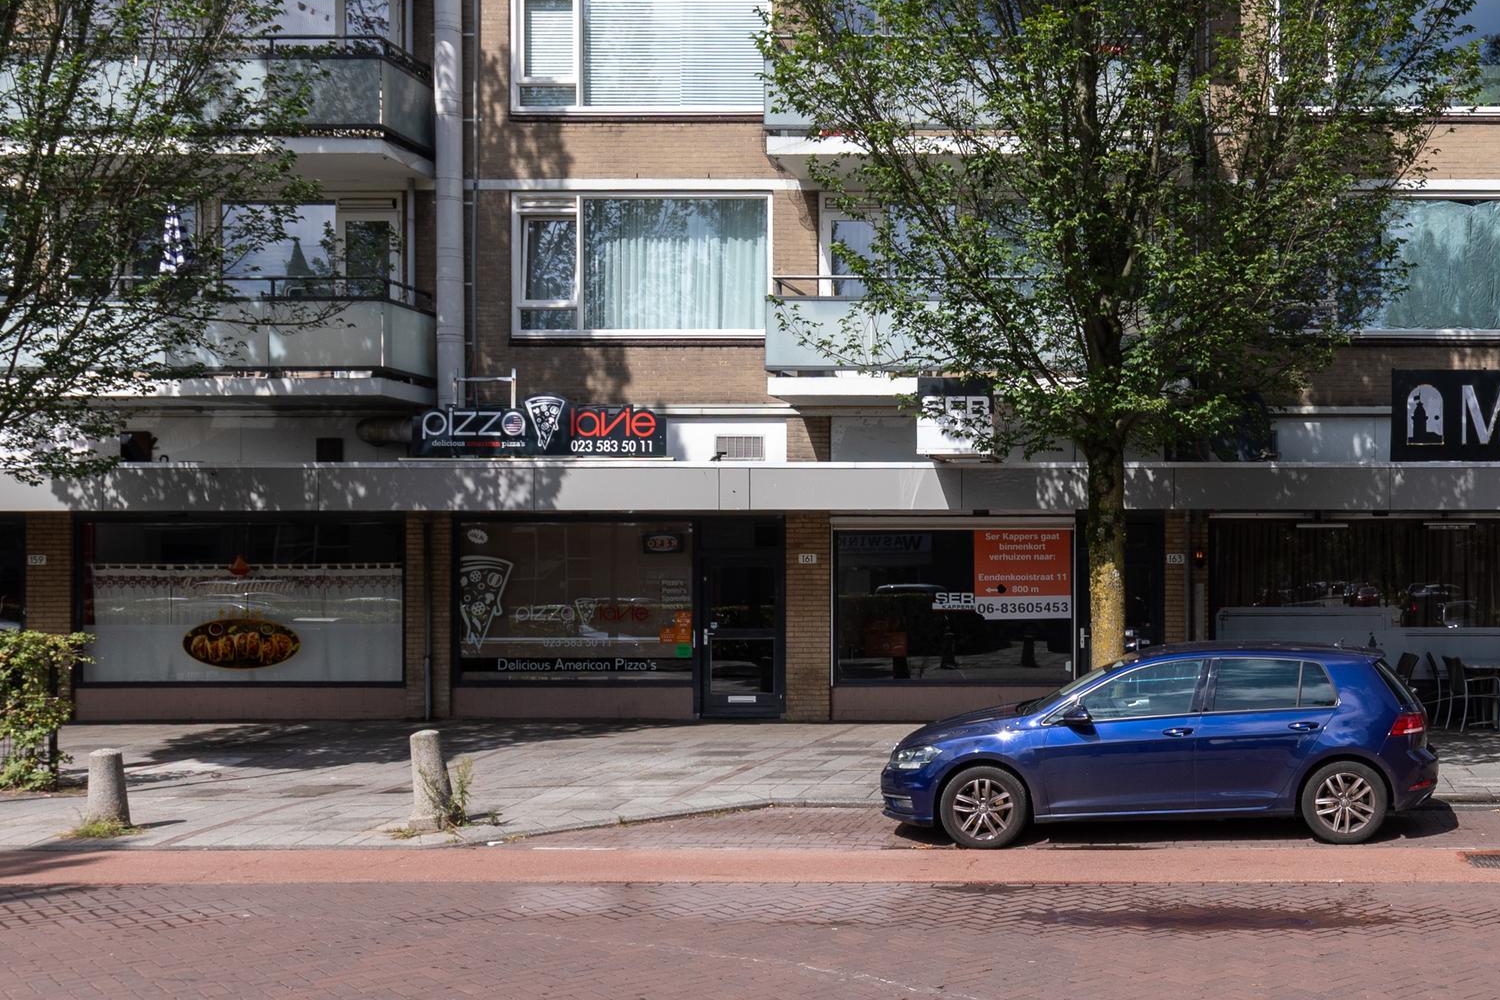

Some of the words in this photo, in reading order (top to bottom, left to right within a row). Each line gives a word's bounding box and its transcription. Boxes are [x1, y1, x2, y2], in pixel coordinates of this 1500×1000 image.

[422, 407, 526, 439] pizza
[570, 407, 656, 437] lavie
[571, 440, 592, 452] 023
[595, 440, 619, 452] 583
[621, 440, 637, 452] 50
[640, 440, 653, 452] 11
[985, 532, 1000, 540] Ser
[1003, 532, 1039, 541] Kappers
[1040, 533, 1060, 541] gaat
[978, 573, 1055, 581] Eendenkooistraat
[1012, 585, 1029, 593] 800
[935, 592, 974, 604] SER
[515, 605, 576, 623] pizza
[977, 602, 1069, 614] 06-83605453
[497, 657, 550, 671] Delicious
[554, 657, 611, 671] American
[615, 657, 657, 671] Pizza's
